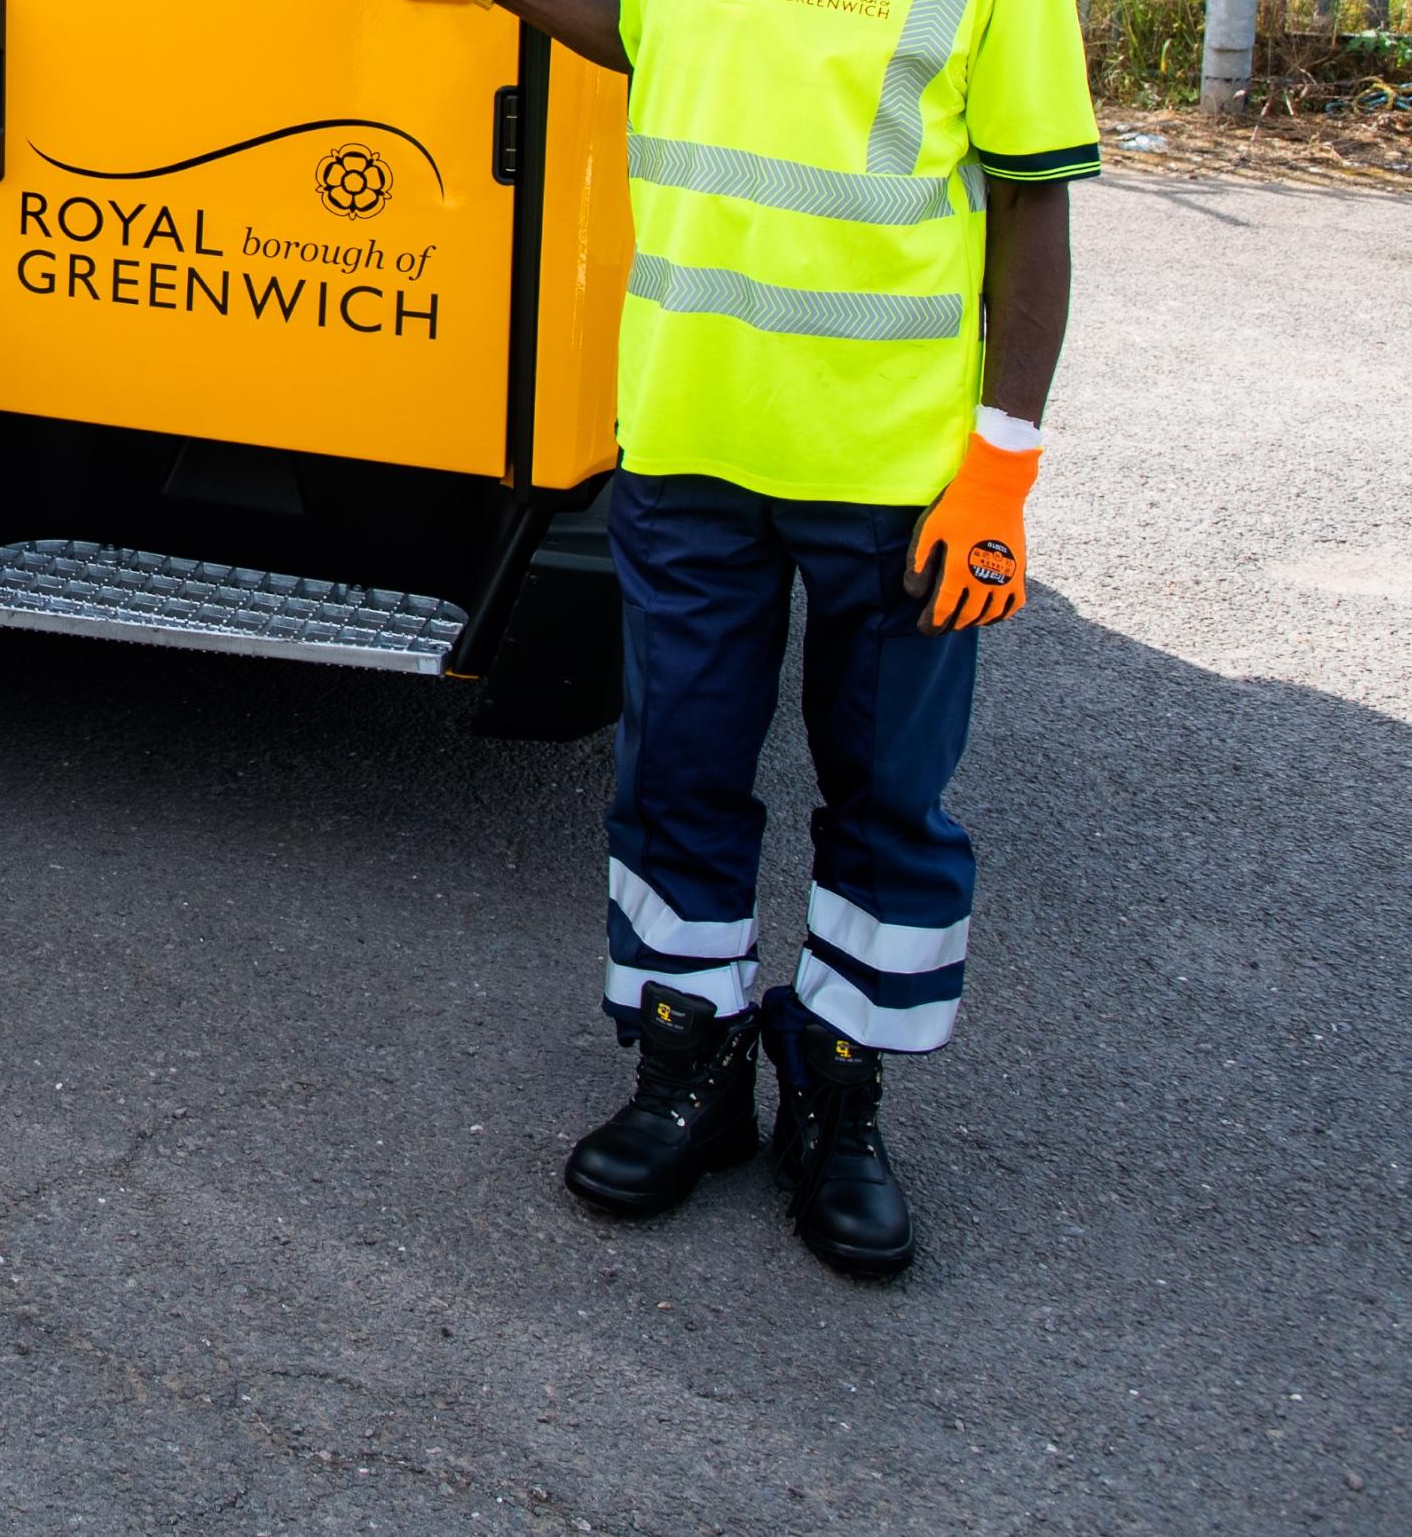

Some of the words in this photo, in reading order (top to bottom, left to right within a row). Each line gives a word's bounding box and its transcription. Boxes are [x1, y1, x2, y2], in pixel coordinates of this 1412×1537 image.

[19, 190, 223, 258] ROYAL
[242, 226, 385, 276] borough
[395, 244, 437, 282] of
[17, 249, 439, 340] GREENWICH
